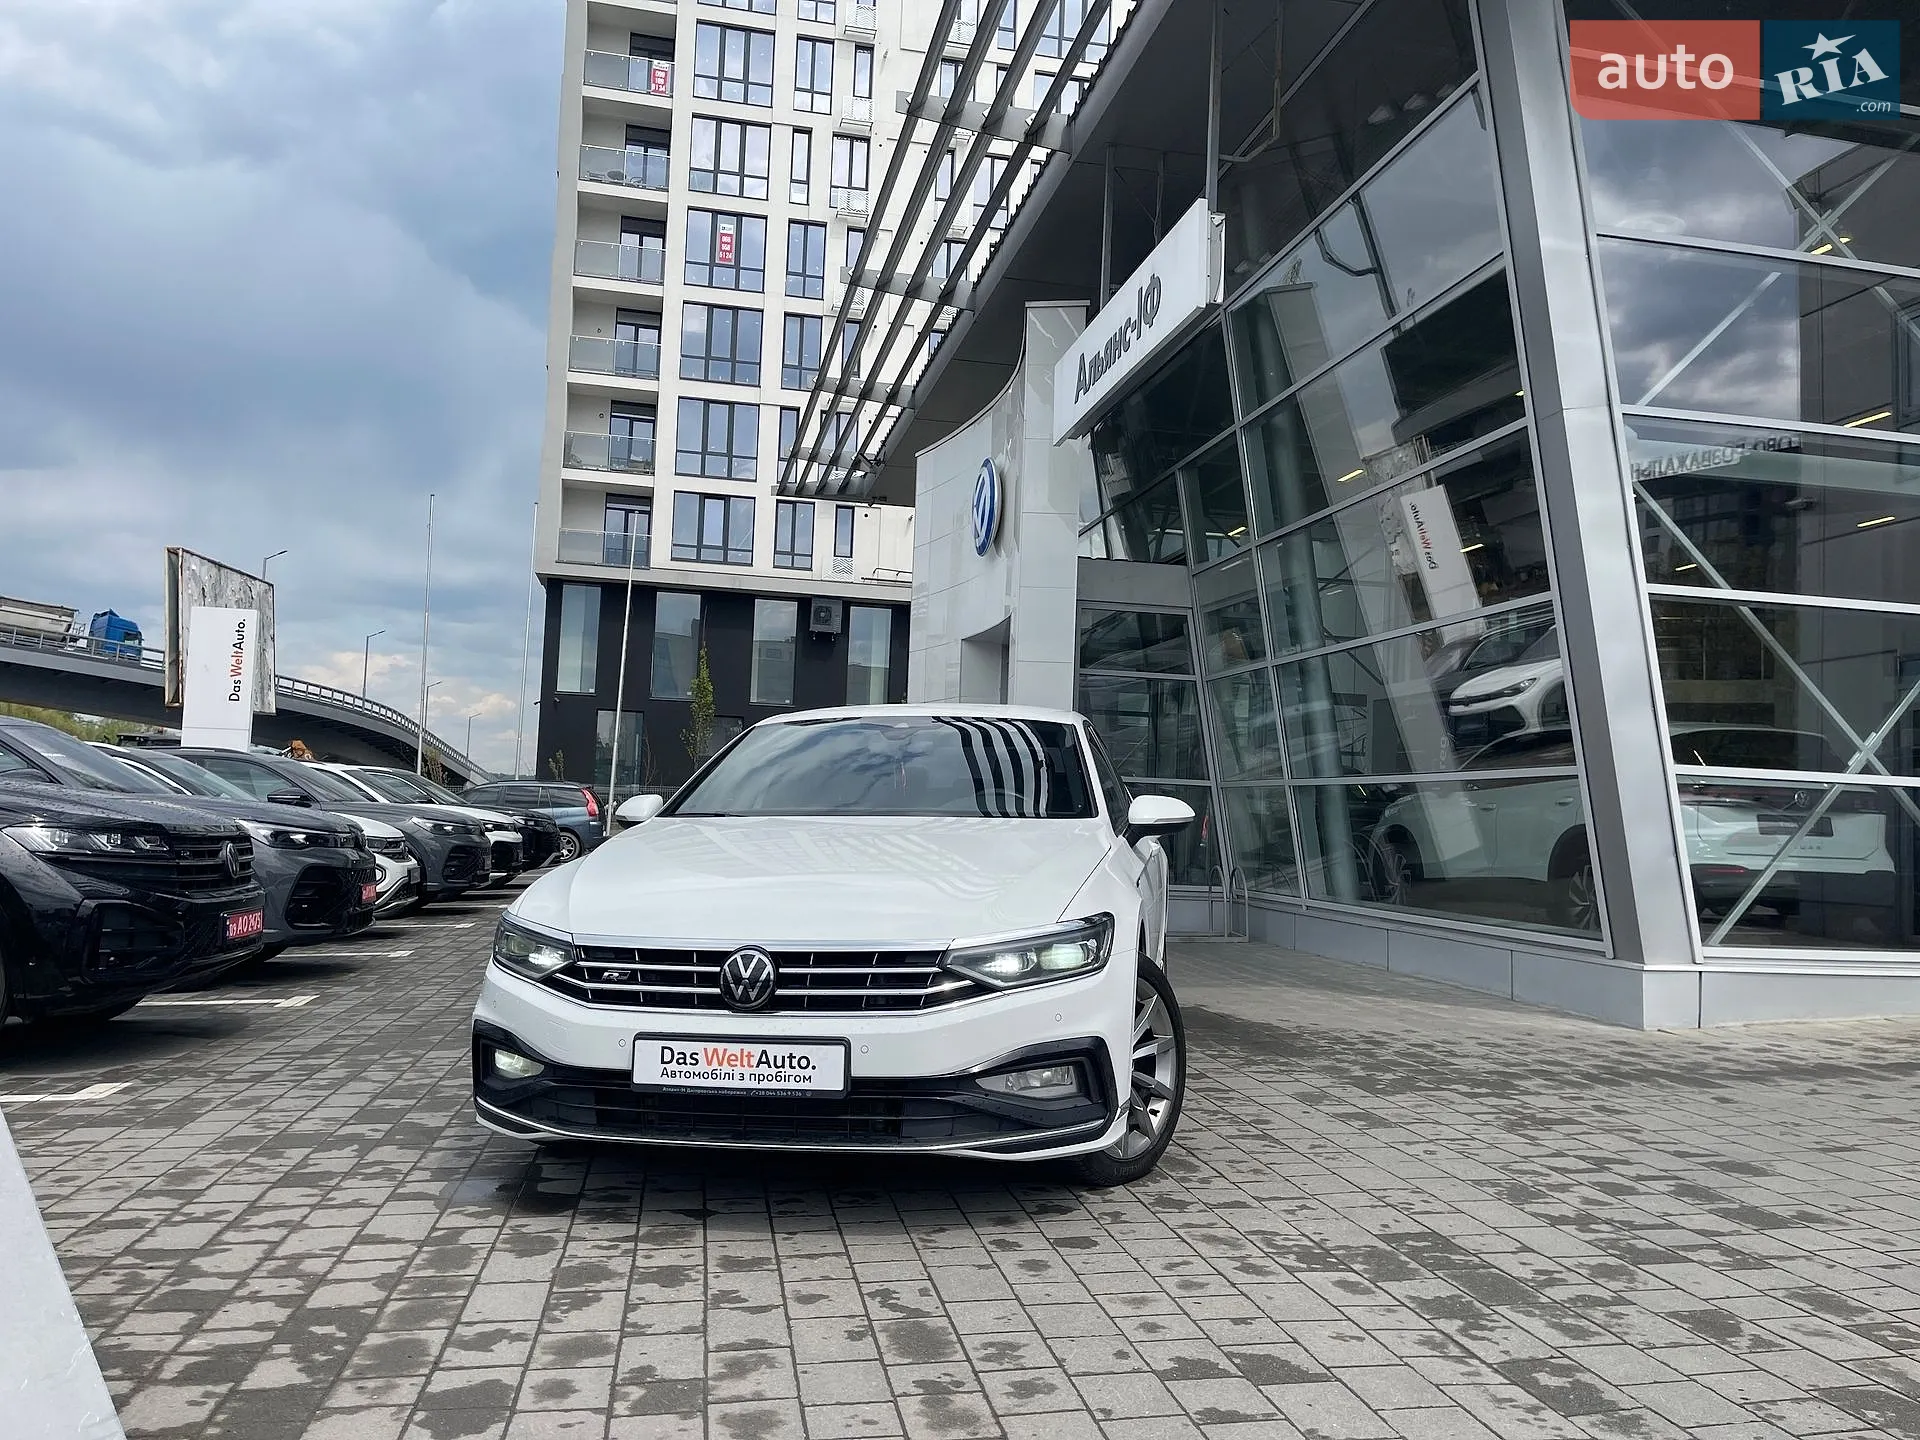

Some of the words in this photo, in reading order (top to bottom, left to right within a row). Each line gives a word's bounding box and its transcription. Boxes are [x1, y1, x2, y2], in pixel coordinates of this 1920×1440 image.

[1074, 273, 1162, 404] Альянс-ІФ
[229, 618, 246, 677] WeltAuto.
[228, 680, 241, 702] Das
[660, 1045, 699, 1067] Das
[703, 1047, 817, 1071] WeltAuto.
[660, 1067, 735, 1081] Автомобілі
[738, 1072, 745, 1081] з
[749, 1071, 812, 1084] пробігом
